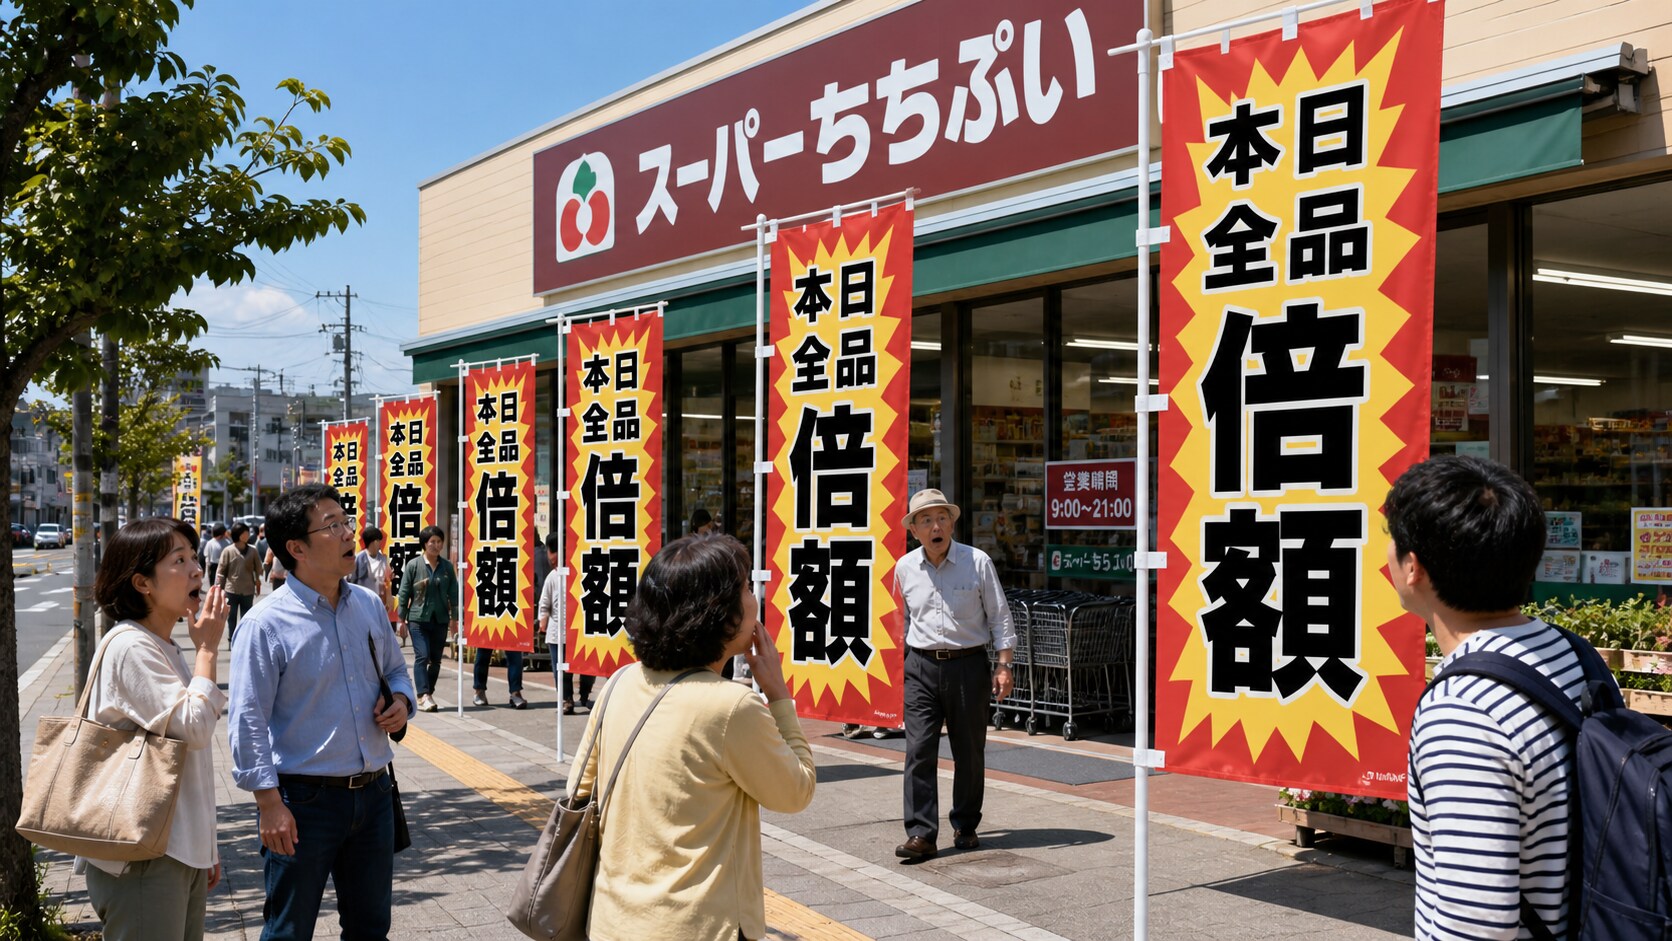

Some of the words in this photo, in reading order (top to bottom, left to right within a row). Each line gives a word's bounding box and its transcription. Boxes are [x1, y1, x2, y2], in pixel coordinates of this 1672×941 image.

[636, 8, 1095, 234] スーパーちちぷい
[1207, 85, 1363, 185] 本日
[1205, 189, 1367, 289] 全品
[795, 261, 873, 322] 本日
[584, 352, 637, 393] 本日
[793, 330, 875, 392] 全品
[391, 421, 422, 446] 本日
[478, 392, 516, 424] 本日
[583, 400, 639, 442] 全品
[334, 442, 356, 461] 本日
[334, 466, 357, 487] 全品
[390, 451, 423, 476] 全品
[477, 431, 518, 463] 全品
[1201, 304, 1364, 701] 倍額
[476, 472, 517, 617] 倍額
[581, 453, 639, 637] 倍額
[789, 405, 873, 666] 倍額
